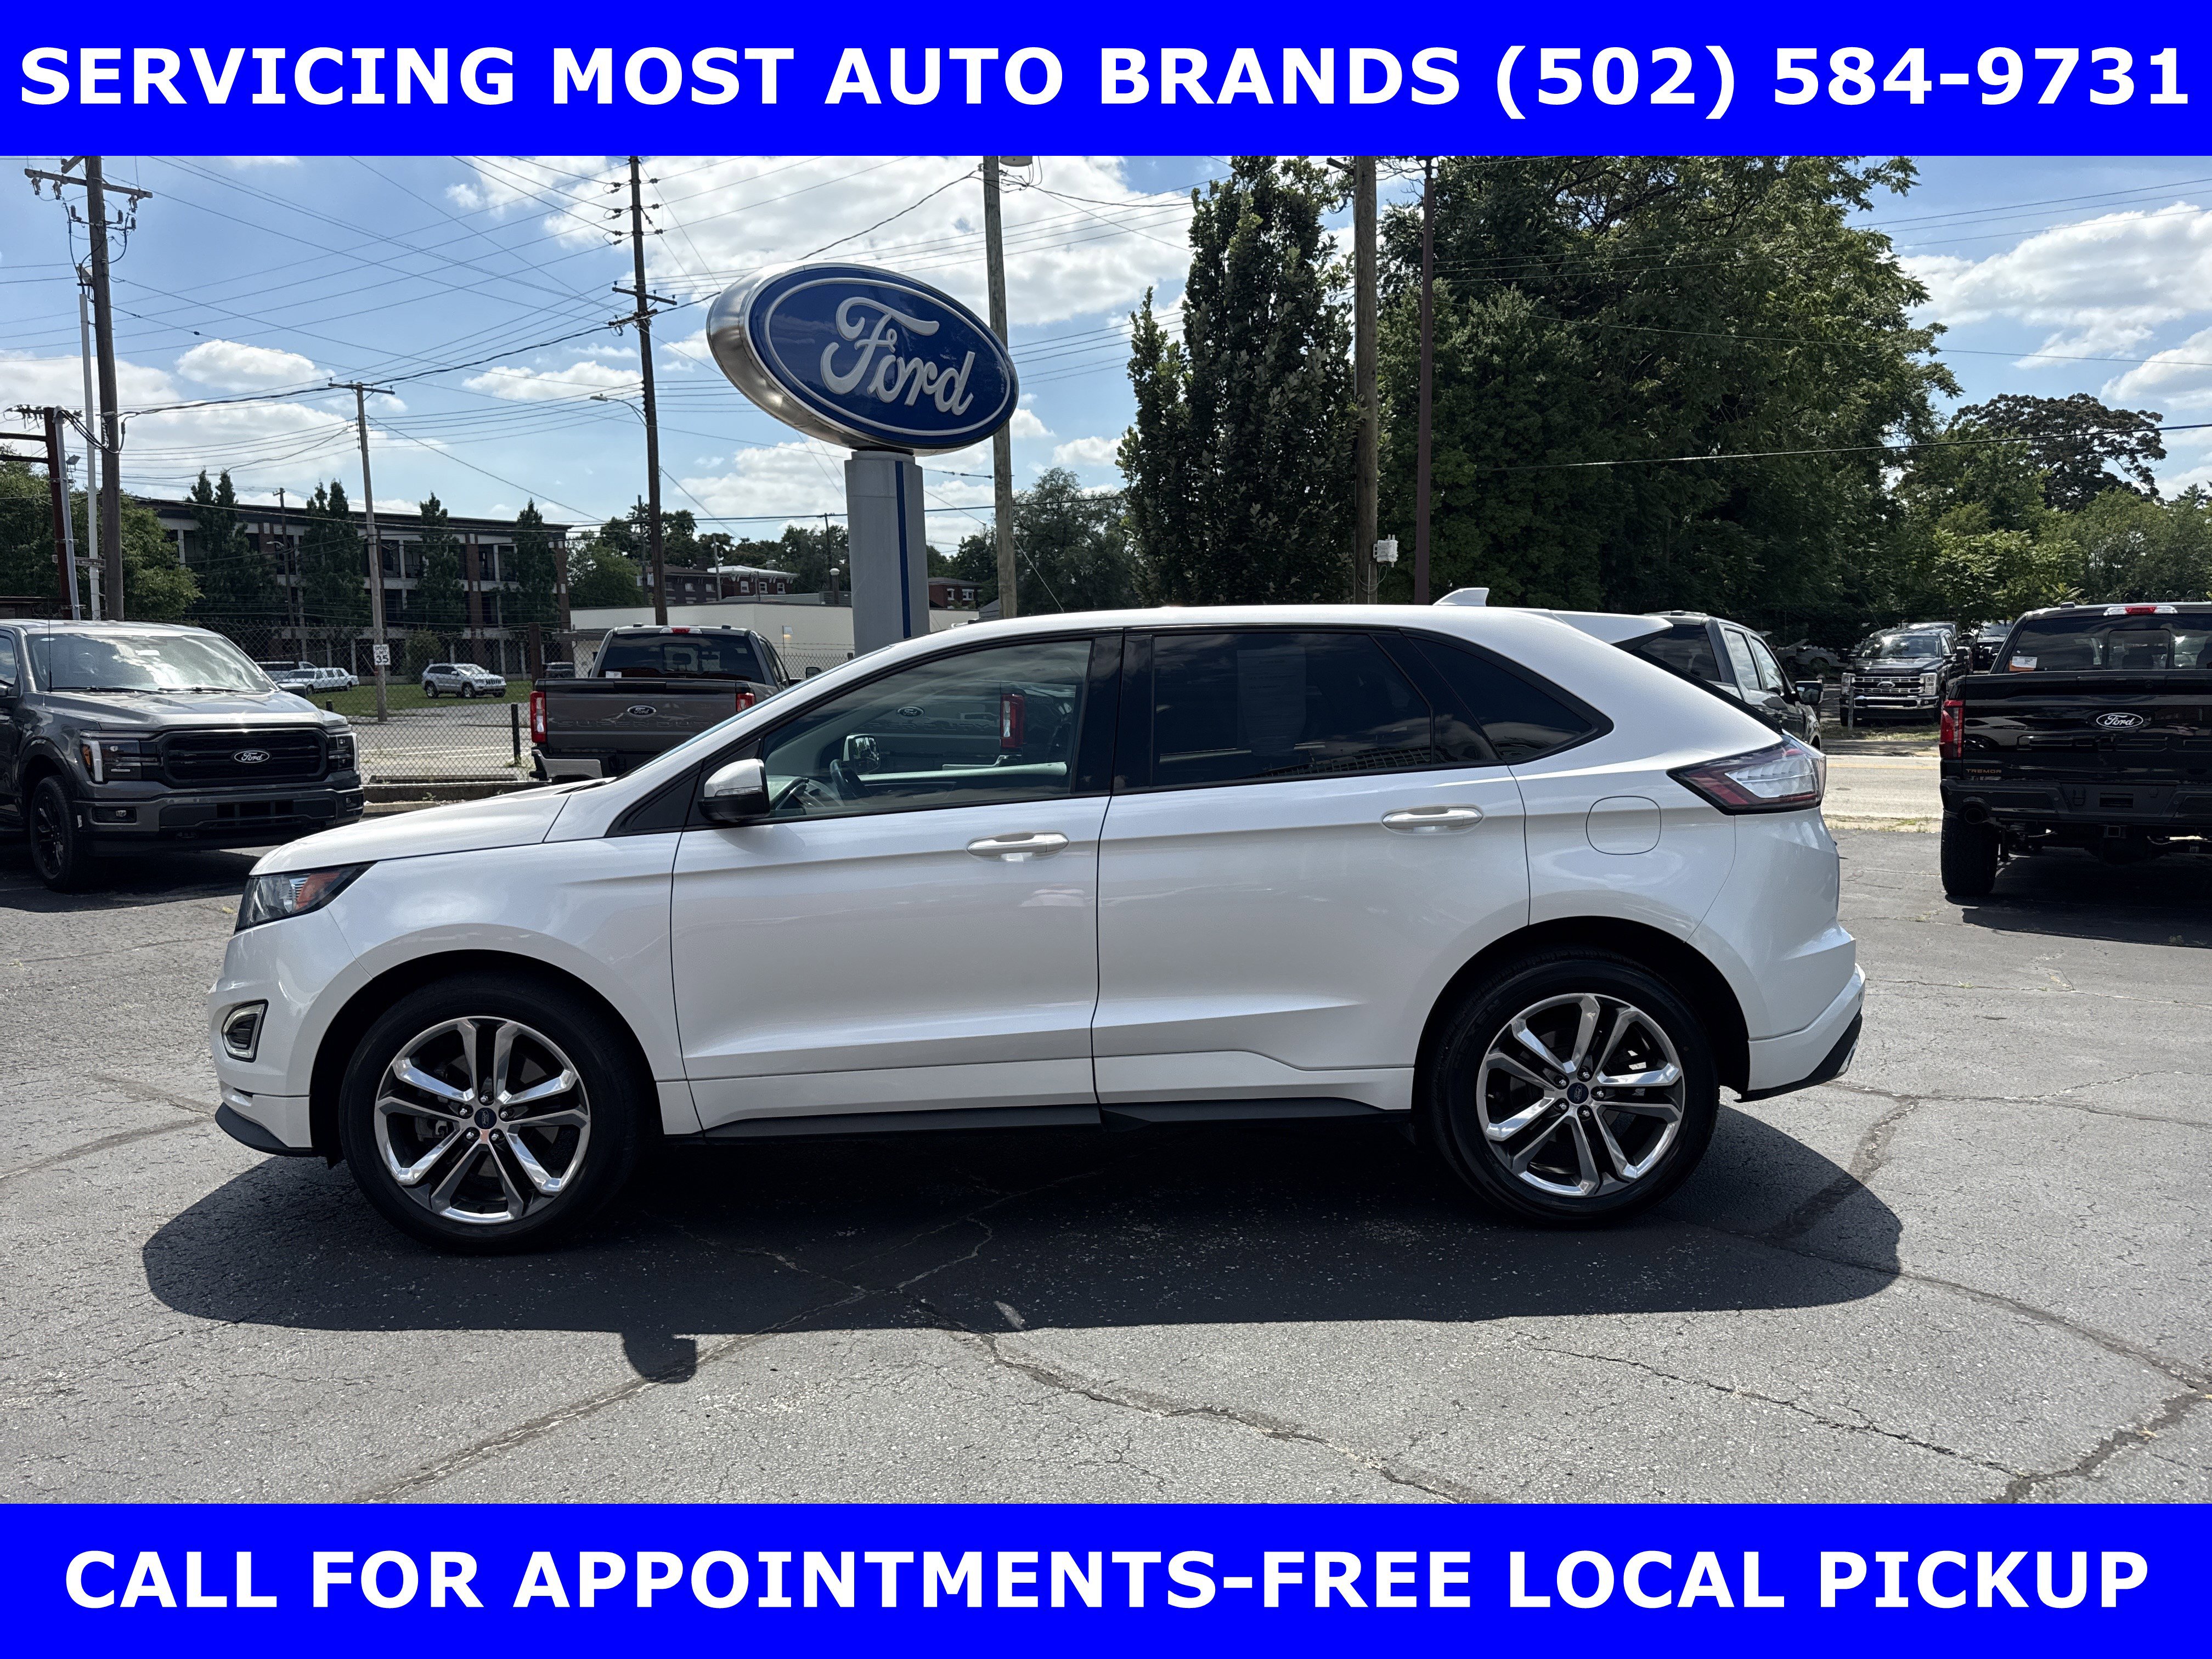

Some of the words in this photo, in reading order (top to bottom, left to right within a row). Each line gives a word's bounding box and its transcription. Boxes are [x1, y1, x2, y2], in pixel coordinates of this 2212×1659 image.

[820, 296, 975, 416] Ford
[376, 655, 388, 663] 35
[2104, 714, 2135, 725] Ford
[241, 752, 265, 761] Ford
